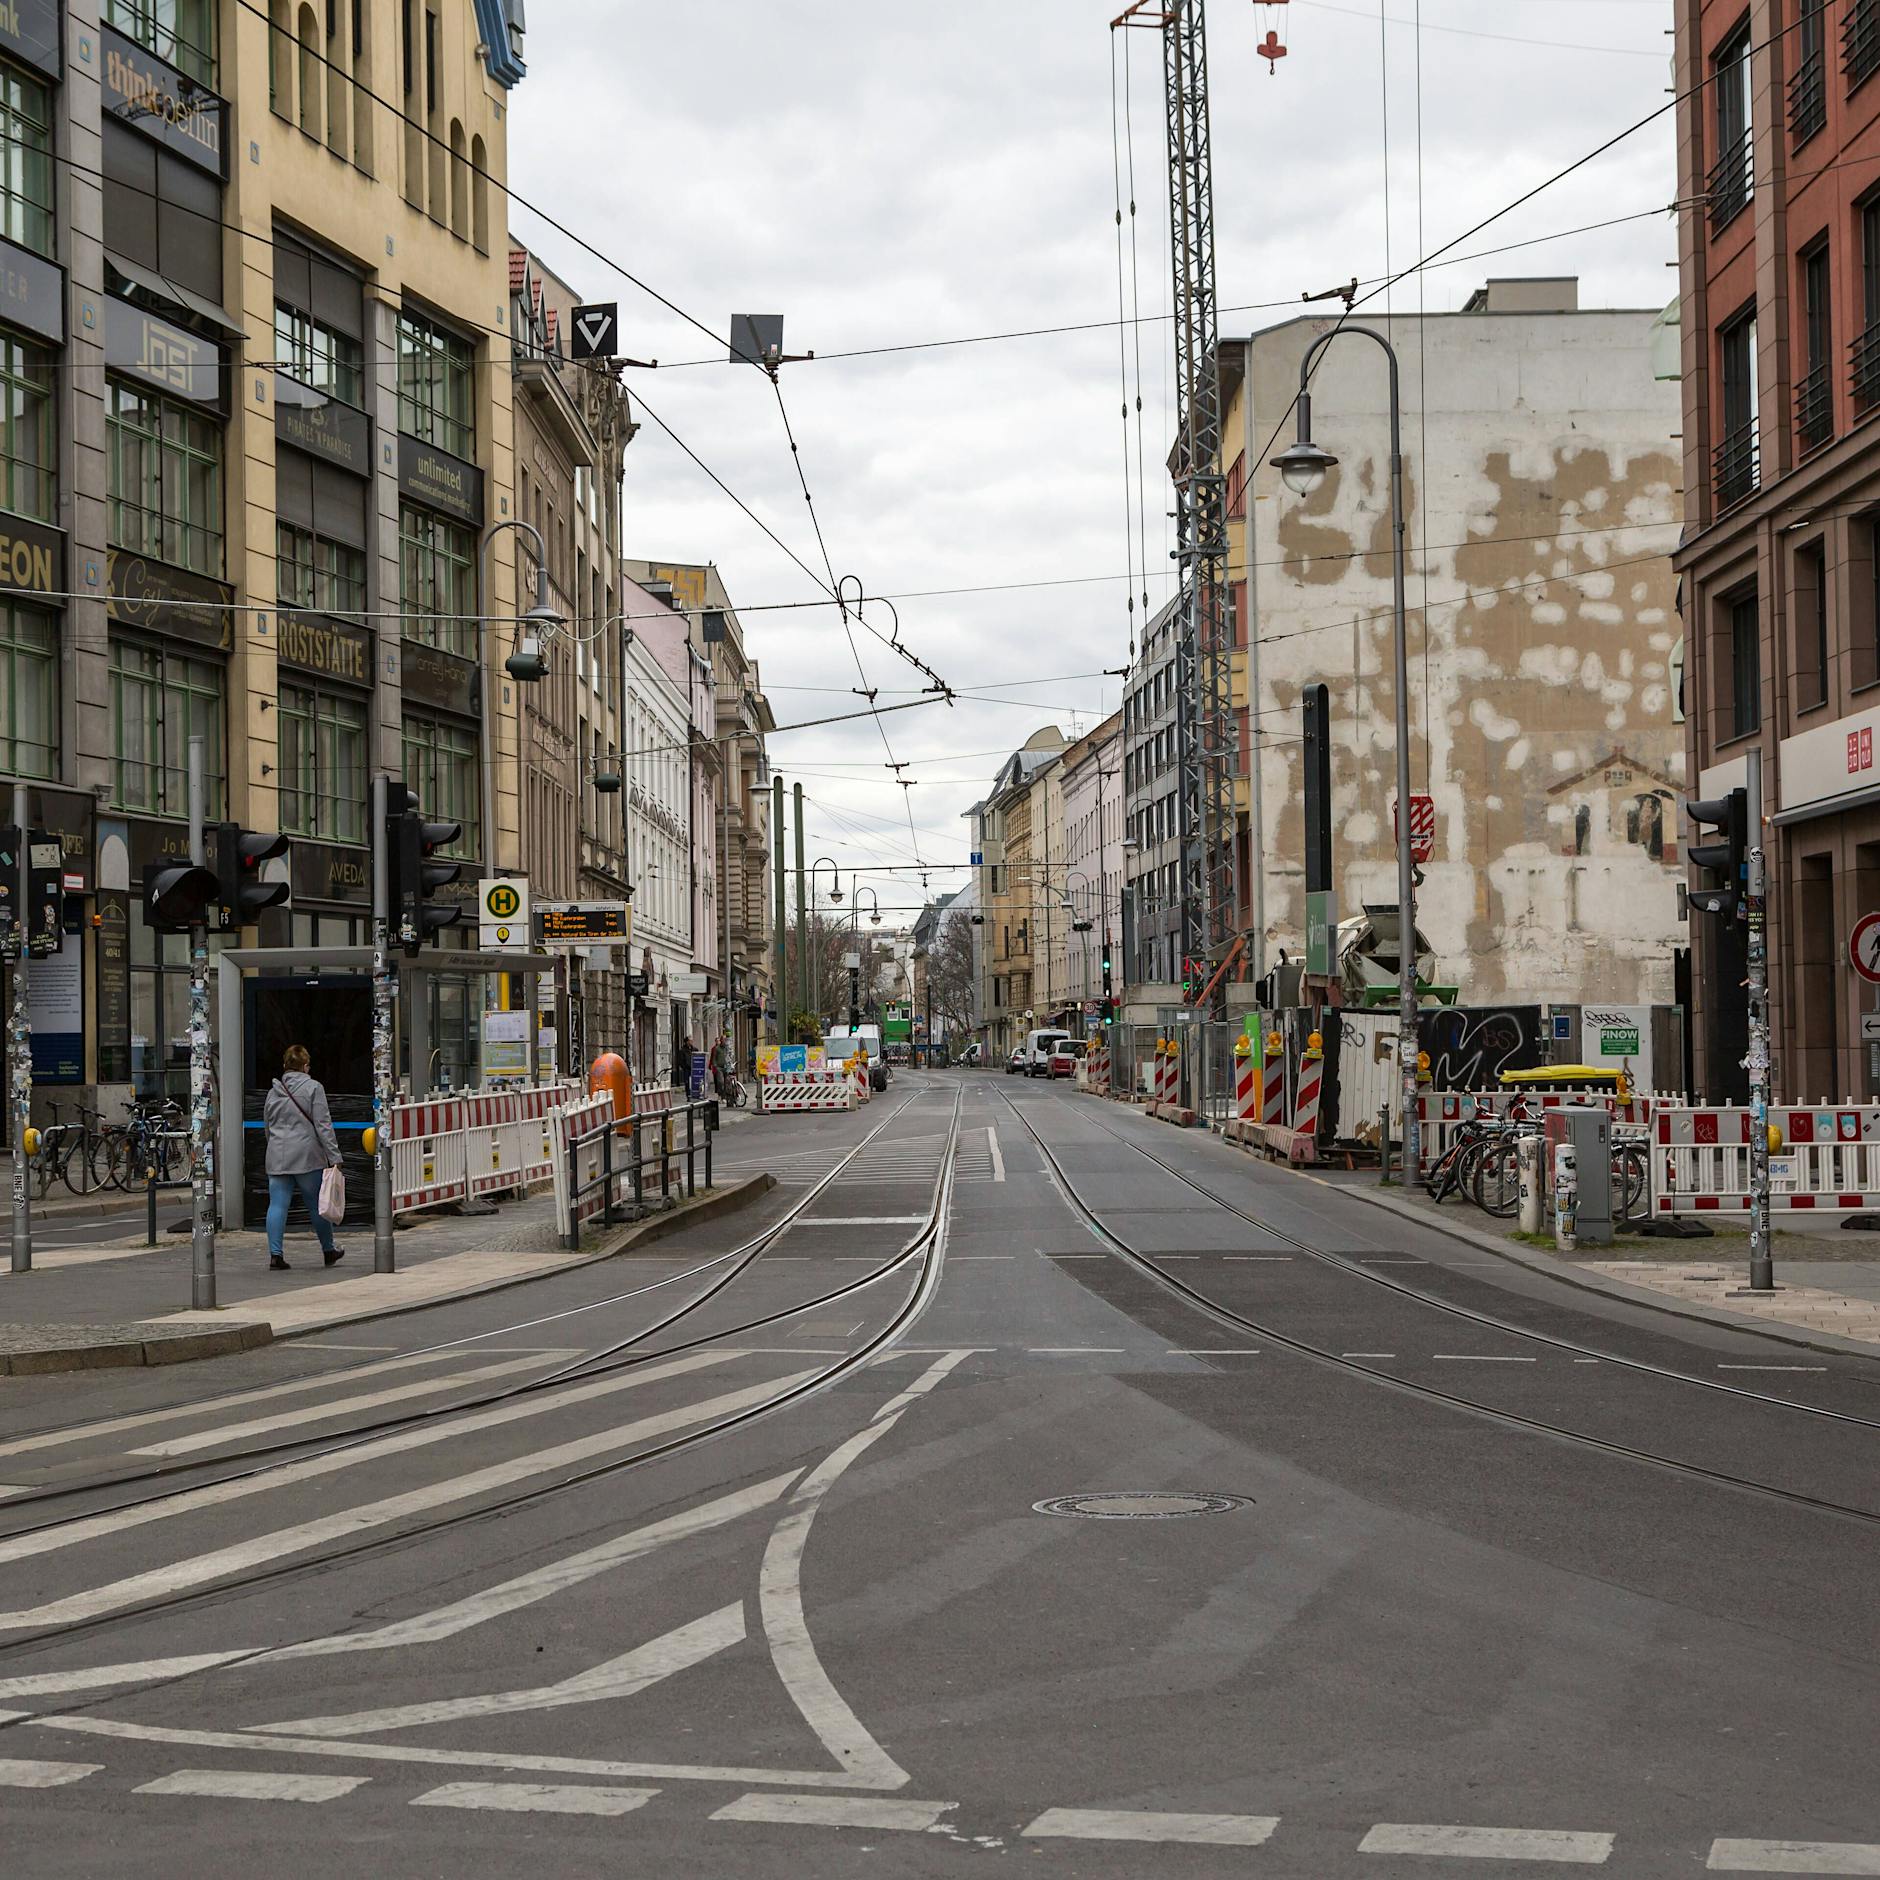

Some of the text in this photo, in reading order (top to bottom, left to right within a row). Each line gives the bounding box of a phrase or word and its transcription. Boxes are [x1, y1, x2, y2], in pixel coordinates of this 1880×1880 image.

[136, 319, 198, 392] JOST
[417, 456, 461, 492] unlimited
[278, 612, 364, 679] RÖSTSTÄTTE
[162, 837, 176, 853] Jo
[329, 861, 366, 885] AVEDA
[495, 892, 511, 911] H
[220, 912, 229, 925] F5
[1601, 1030, 1638, 1039] FINOW
[1761, 1211, 1769, 1230] BNE
